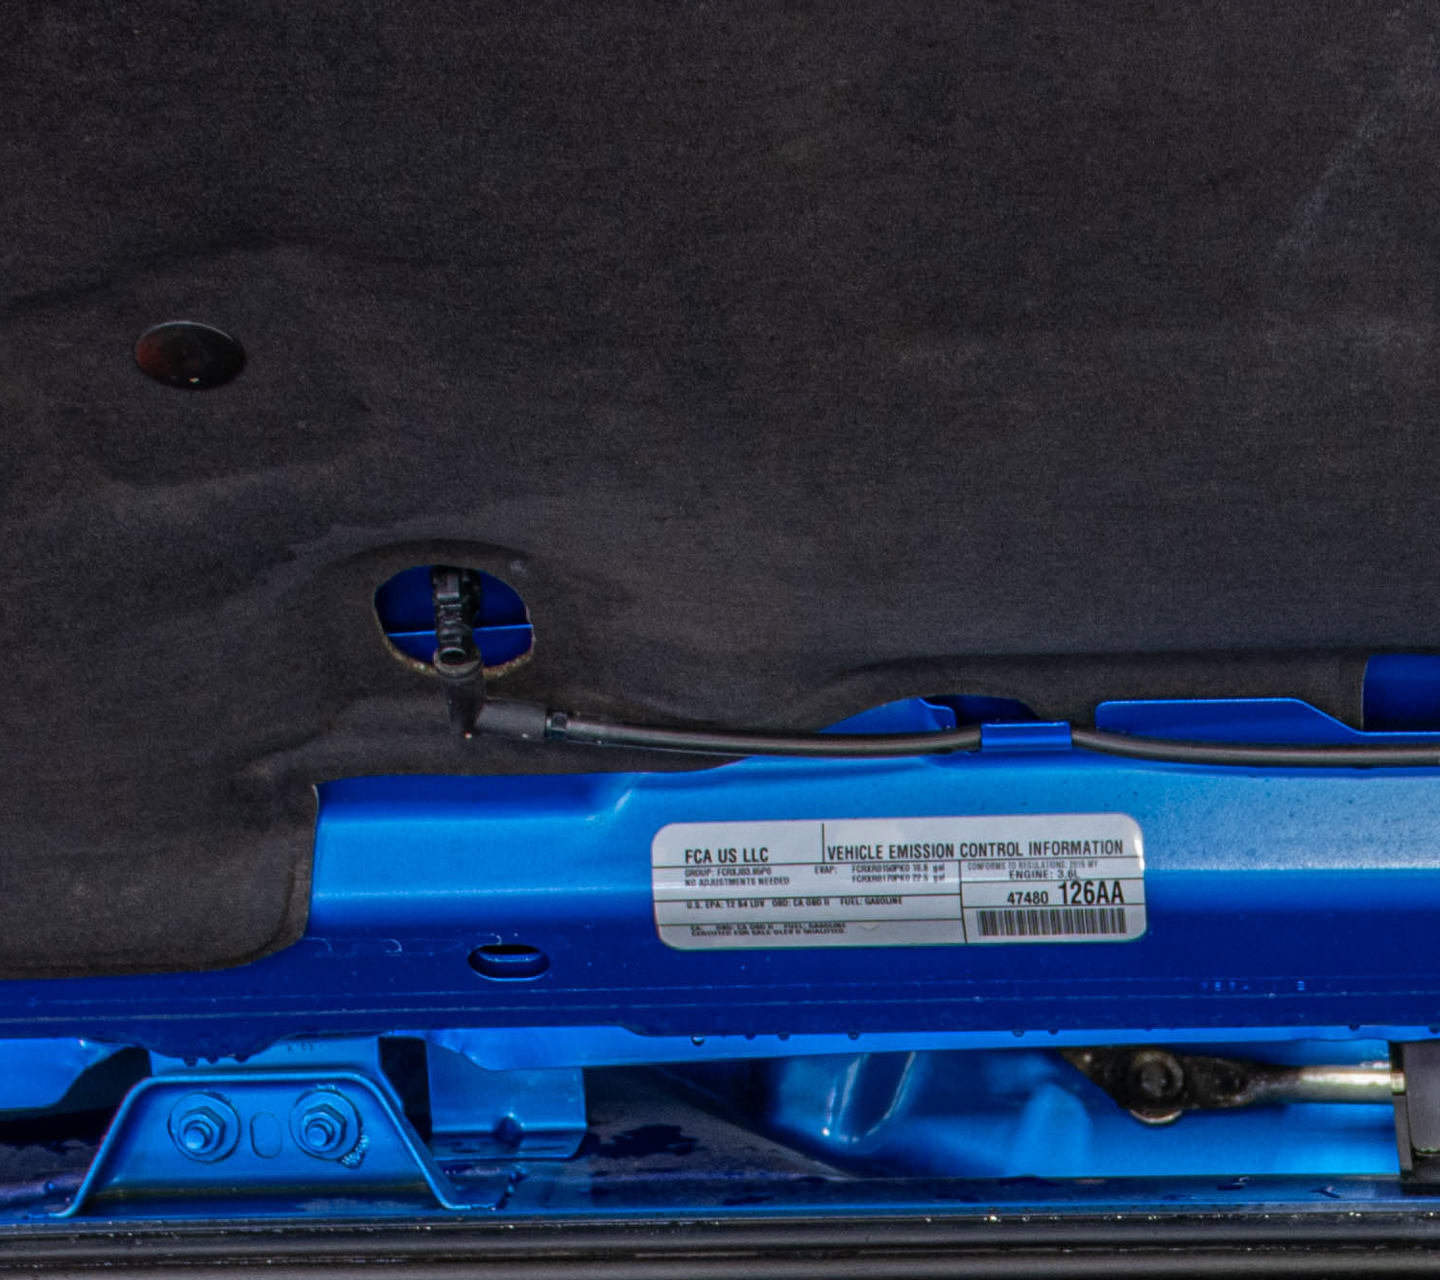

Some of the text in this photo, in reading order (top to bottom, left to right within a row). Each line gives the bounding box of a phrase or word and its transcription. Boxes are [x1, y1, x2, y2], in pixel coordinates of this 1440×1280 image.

[685, 846, 769, 864] FCA US LLC
[828, 838, 1123, 861] VEHICLE EMISSION CONTROL INFORMATION
[1010, 868, 1079, 880] ENGINE: 3.6L
[1007, 880, 1125, 905] 47480 126AA
